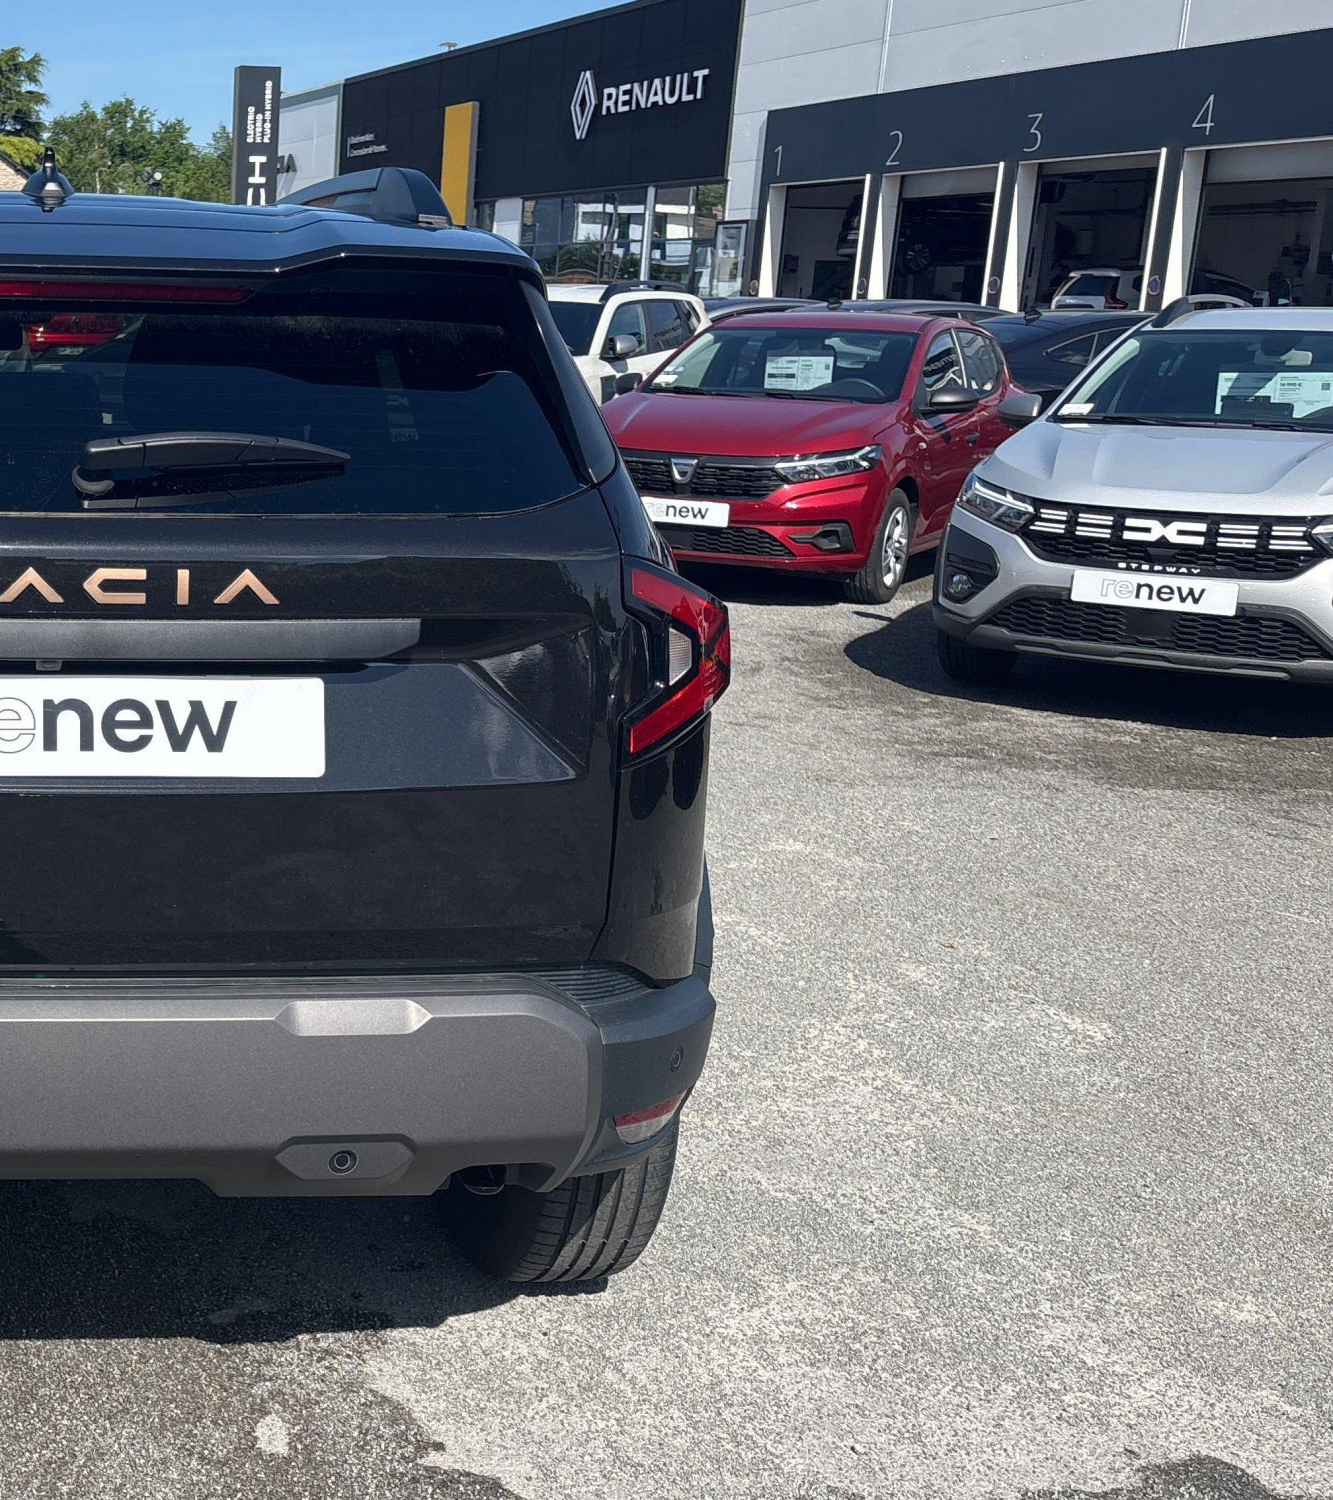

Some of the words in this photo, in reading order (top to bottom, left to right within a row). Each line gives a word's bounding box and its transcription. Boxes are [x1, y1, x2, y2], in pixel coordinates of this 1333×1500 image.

[264, 80, 273, 110] HYBRID
[601, 68, 710, 116] RENAULT
[254, 113, 264, 143] HYBRID
[1191, 93, 1216, 136] 4
[1022, 112, 1044, 152] 3
[774, 145, 783, 176] 1
[885, 130, 903, 166] 2
[645, 502, 709, 520] renew
[1117, 562, 1201, 574] STEPWAY
[1100, 578, 1207, 605] renew
